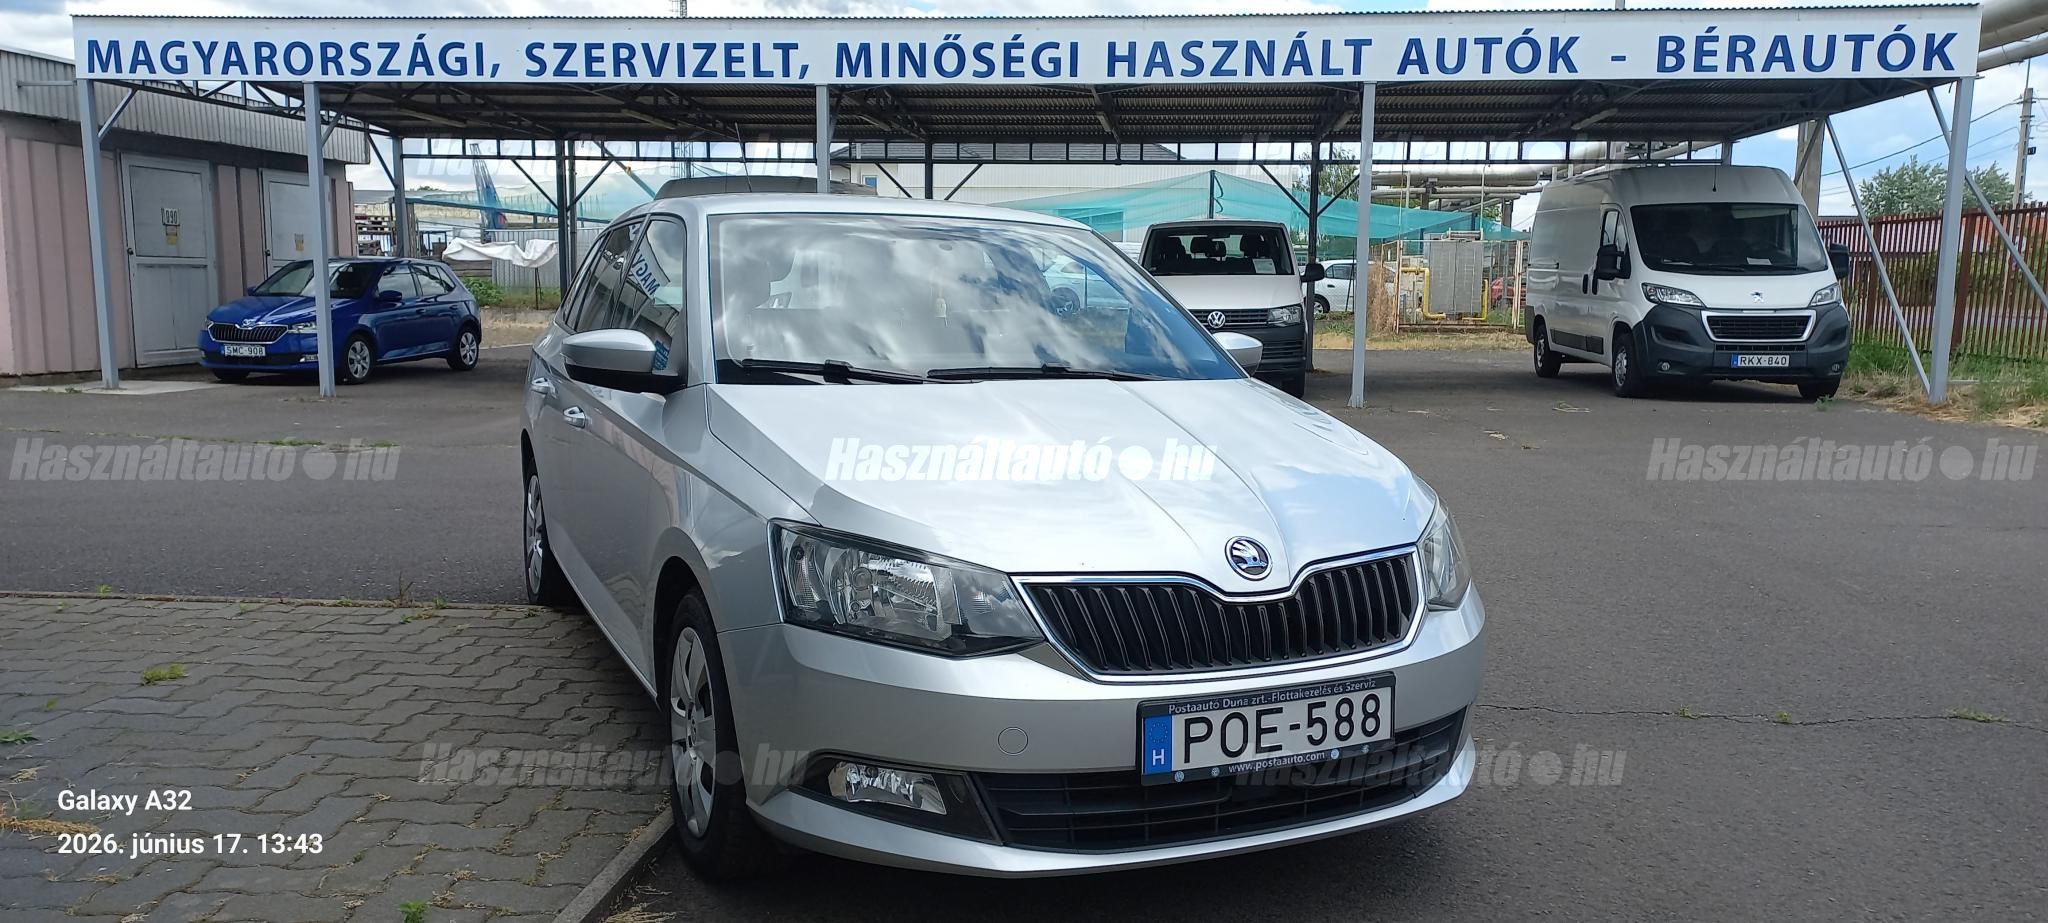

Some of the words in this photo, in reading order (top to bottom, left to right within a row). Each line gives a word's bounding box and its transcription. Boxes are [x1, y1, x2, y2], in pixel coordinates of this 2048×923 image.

[86, 33, 502, 81] MAGYARORSZÁGI,
[523, 41, 801, 81] SZERVIZELT,
[834, 33, 1080, 80] MINŐSÉGI
[1105, 33, 1373, 79] HASZNÁLT
[1395, 28, 1582, 76] AUTÓK
[1656, 24, 1959, 74] BÉRAUTÓK
[226, 346, 263, 355] SMC-908
[1740, 356, 1787, 366] RKX-840
[1222, 698, 1249, 708] Duna
[1333, 683, 1343, 693] és
[1345, 679, 1377, 692] Szerviz
[1183, 693, 1381, 764] POE-588
[1152, 749, 1165, 766] H
[1228, 750, 1325, 773] www.postaauto.com
